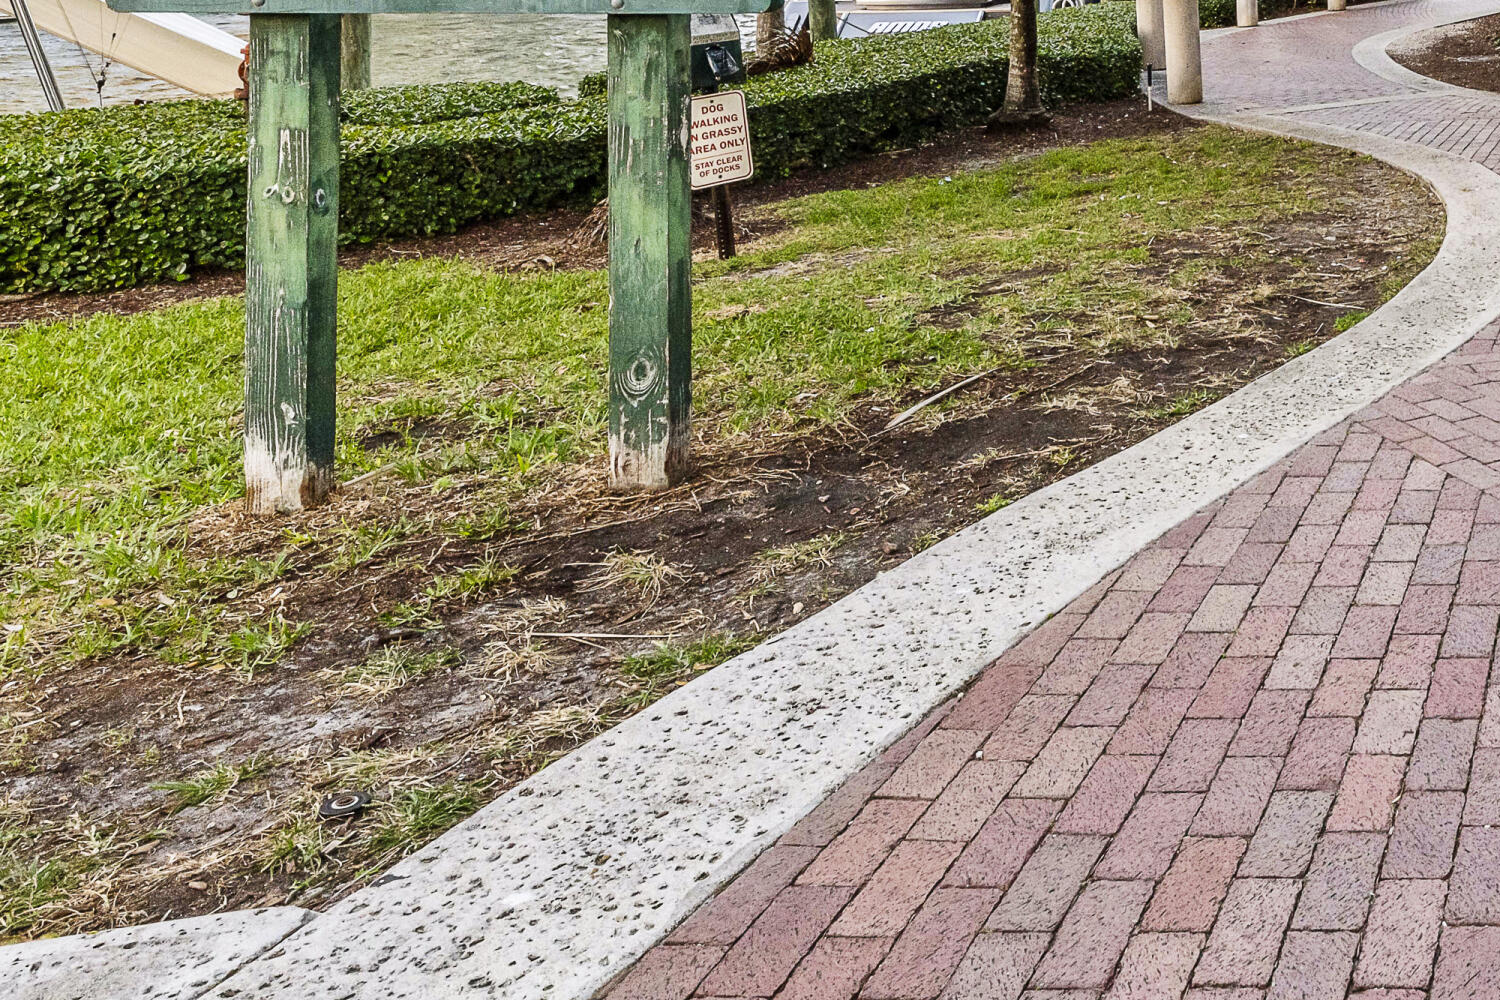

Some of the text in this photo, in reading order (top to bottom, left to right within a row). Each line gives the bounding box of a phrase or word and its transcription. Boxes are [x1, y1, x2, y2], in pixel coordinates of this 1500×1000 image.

[701, 103, 724, 115] DOG
[691, 113, 738, 129] WALKING
[690, 125, 743, 142] N GRASSY
[719, 137, 746, 150] ONLY
[695, 154, 743, 170] STAY CLEAR
[699, 163, 741, 178] OF DOCKS
